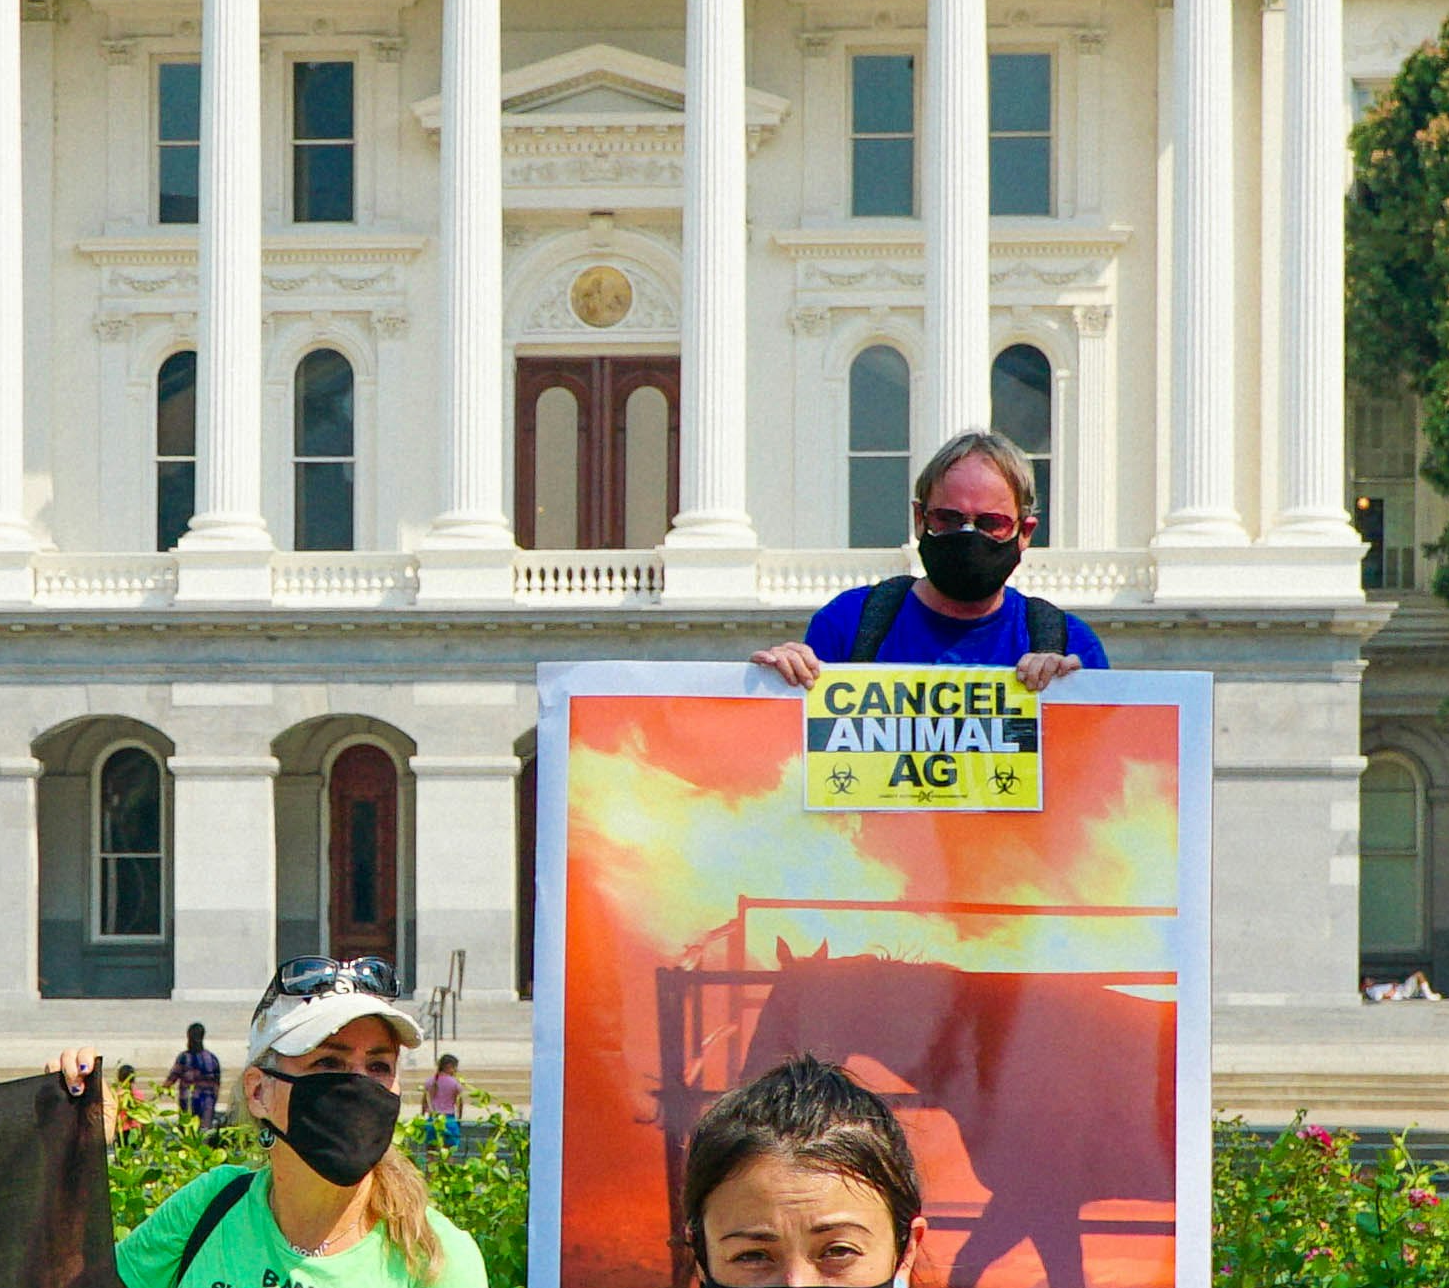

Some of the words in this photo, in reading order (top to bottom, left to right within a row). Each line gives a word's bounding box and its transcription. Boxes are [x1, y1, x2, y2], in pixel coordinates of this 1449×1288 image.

[824, 682, 1022, 716] CANCEL
[825, 717, 1020, 752] ANIMAL
[888, 754, 958, 787] AG
